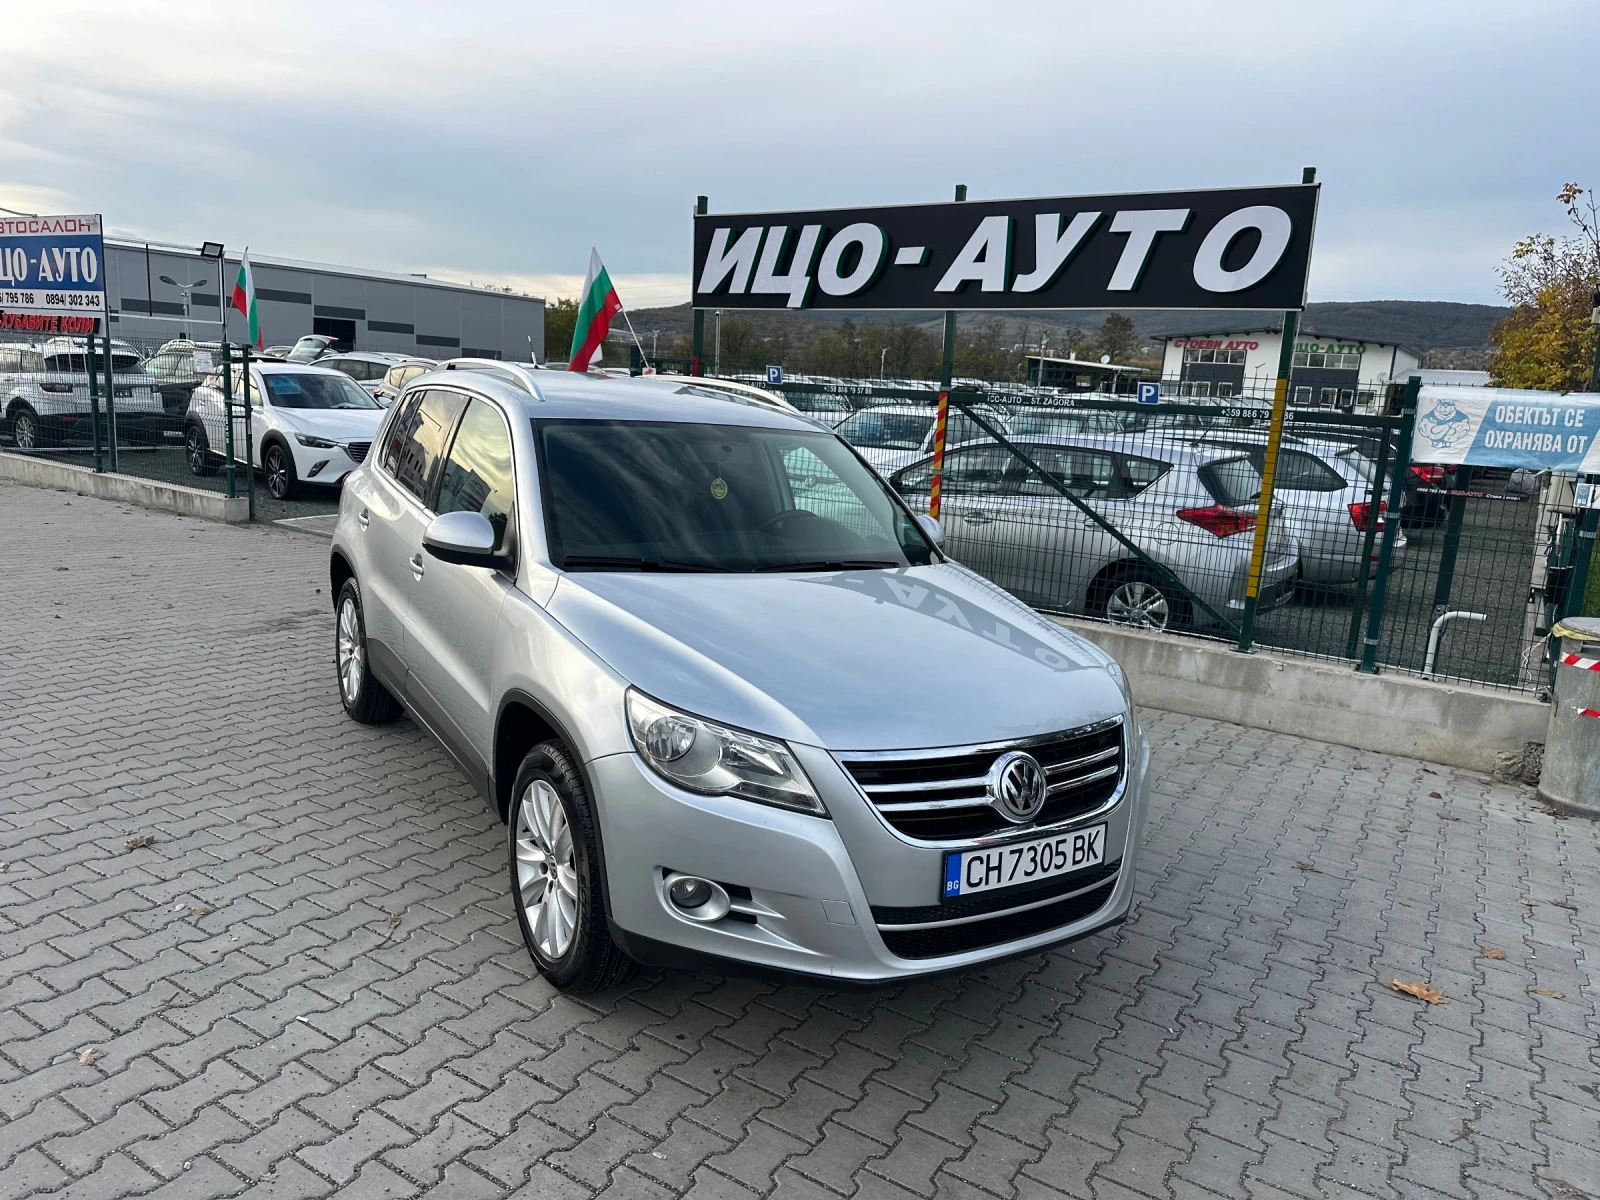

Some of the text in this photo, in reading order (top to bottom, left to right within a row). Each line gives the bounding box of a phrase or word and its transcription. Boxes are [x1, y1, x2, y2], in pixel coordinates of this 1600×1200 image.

[697, 205, 1292, 308] ИЦО-АУТО
[5, 291, 19, 304] 795
[20, 292, 35, 305] 786
[68, 294, 83, 306] 302
[84, 294, 100, 307] 343
[60, 315, 95, 335] КОЛИ
[1174, 338, 1259, 351] СТОЕВИ АУТО
[769, 368, 778, 382] P
[1042, 397, 1075, 407] ZAGORA
[1142, 386, 1155, 402] P
[1495, 405, 1585, 428] ОБЕКТЪТ СЕ
[1484, 430, 1588, 454] ОХРАНЯВА ОТ
[966, 829, 1101, 888] CH 7305 BK
[946, 880, 959, 892] BG
